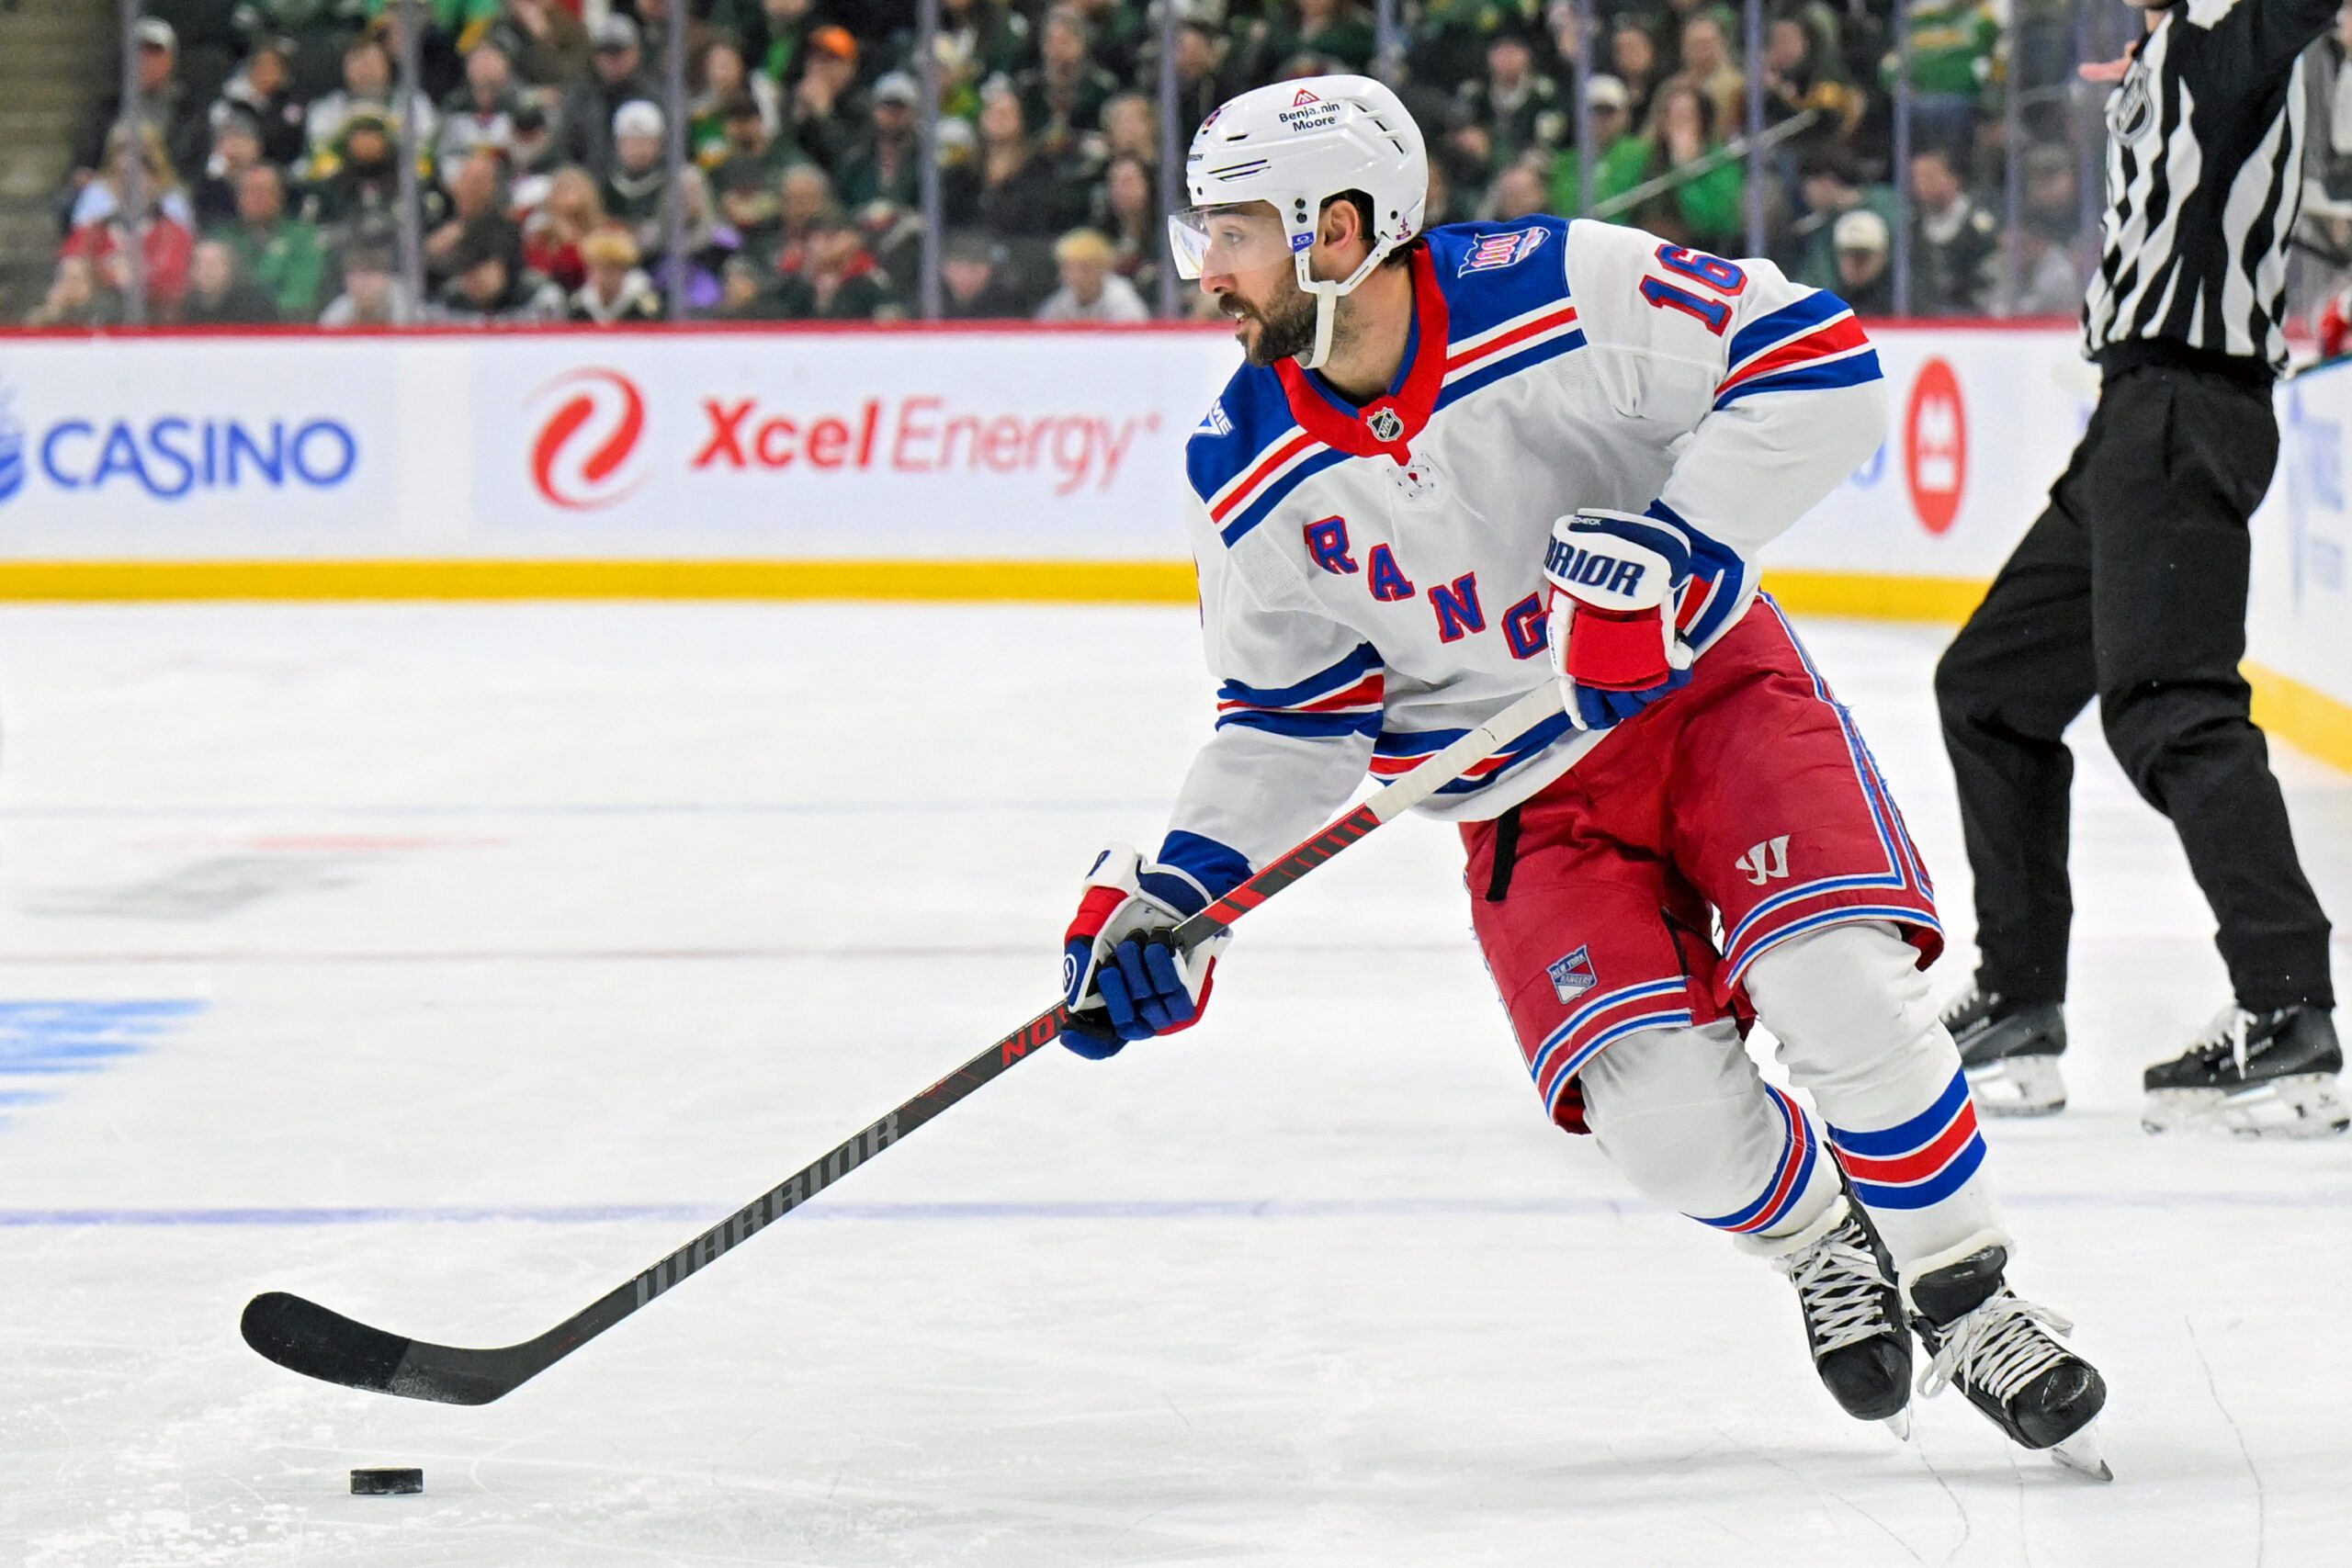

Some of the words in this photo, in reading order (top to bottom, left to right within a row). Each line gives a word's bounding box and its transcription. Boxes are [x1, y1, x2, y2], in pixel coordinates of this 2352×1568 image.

[1293, 116, 1335, 131] Moore
[1639, 243, 1748, 337] 16
[40, 416, 359, 501] CASINO
[690, 396, 881, 471] Xcel
[890, 395, 1139, 497] Energy
[1303, 514, 1549, 660] RANG
[1544, 533, 1646, 598] RRIOR
